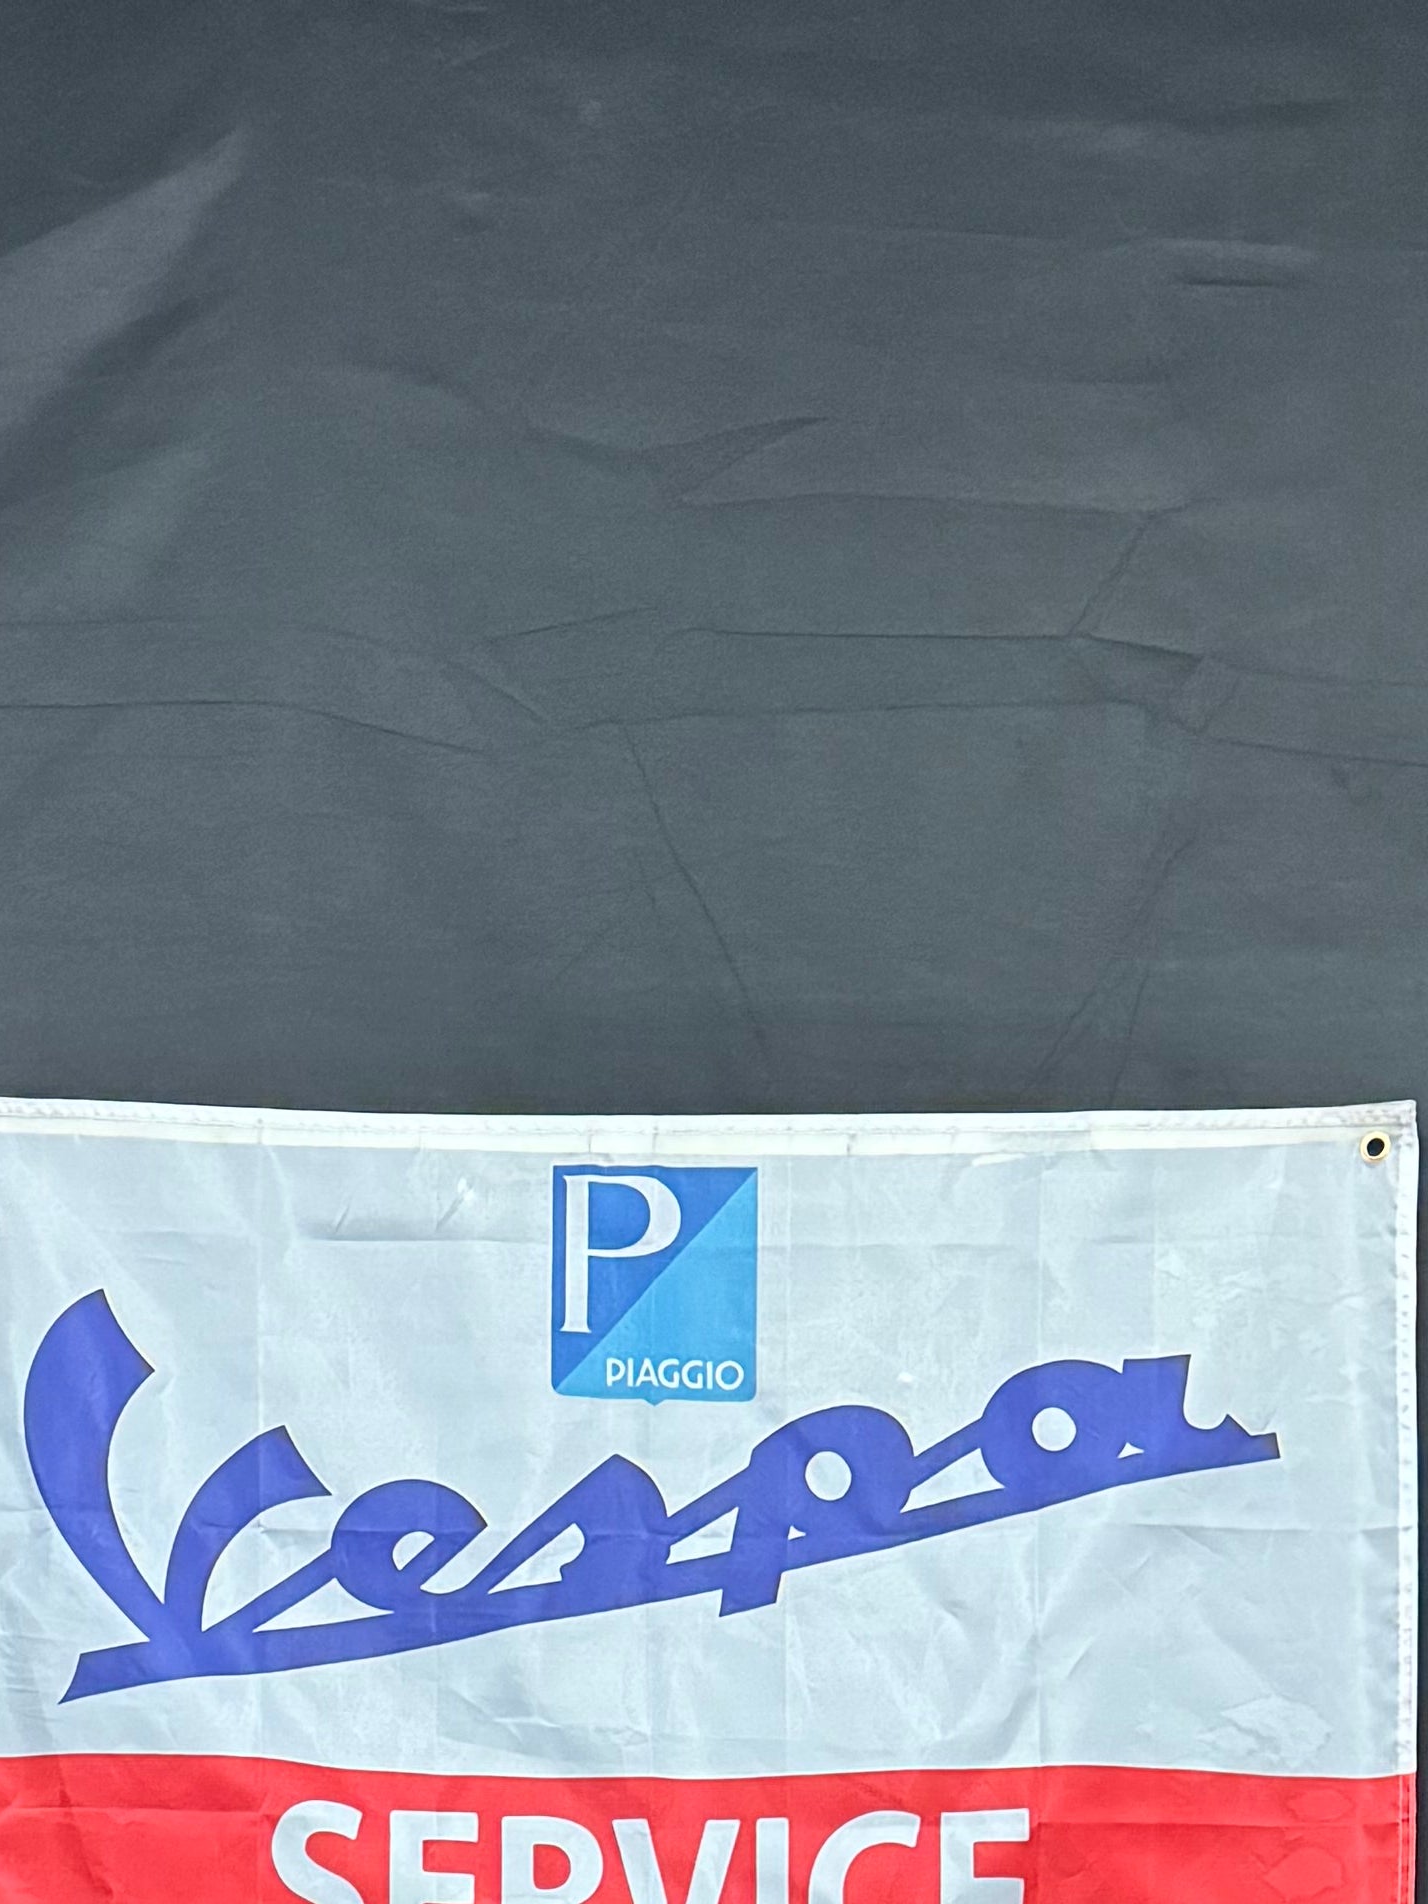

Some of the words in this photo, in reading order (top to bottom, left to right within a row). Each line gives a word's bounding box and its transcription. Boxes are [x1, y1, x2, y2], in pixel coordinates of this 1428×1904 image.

[559, 1174, 682, 1334] P
[605, 1356, 746, 1391] PIAGGIO
[22, 1288, 1280, 1704] Vespa
